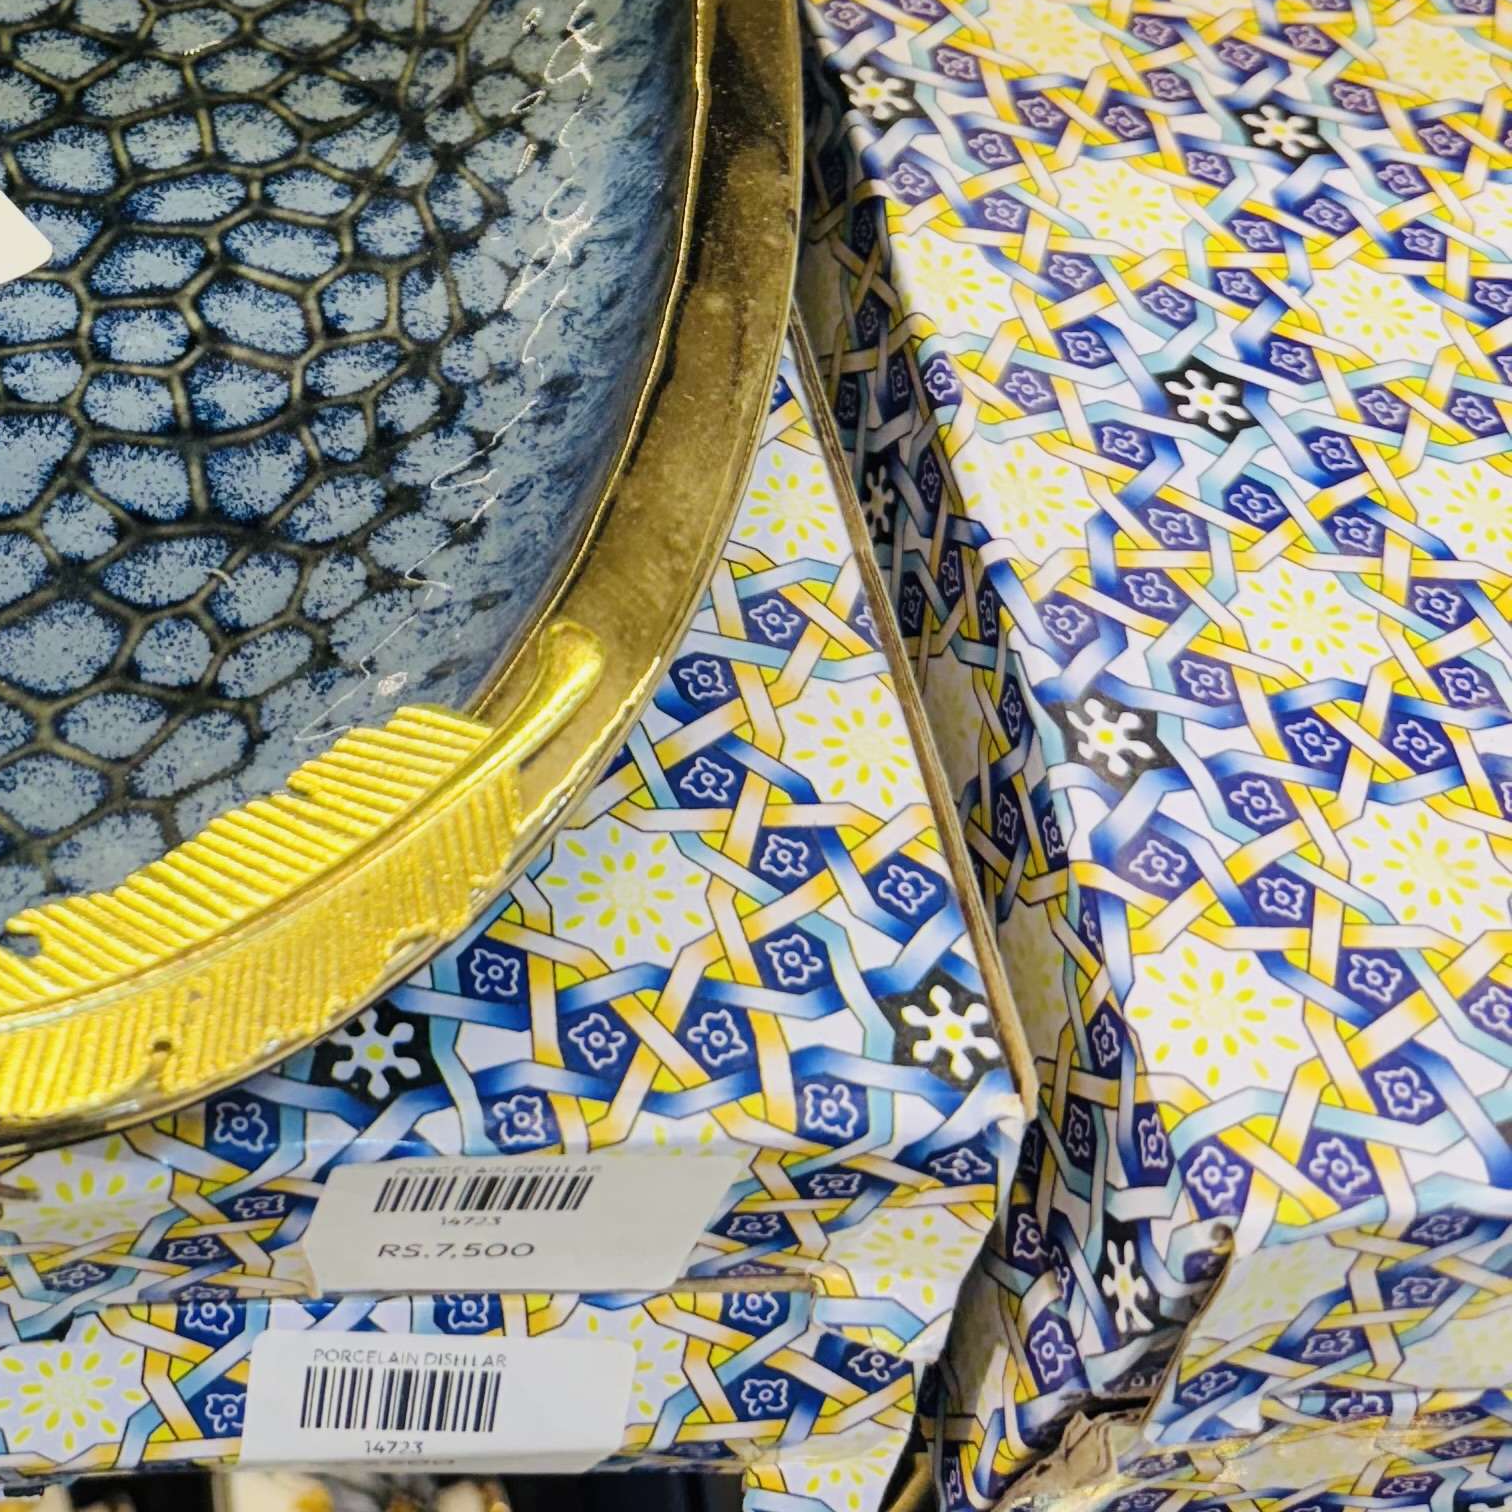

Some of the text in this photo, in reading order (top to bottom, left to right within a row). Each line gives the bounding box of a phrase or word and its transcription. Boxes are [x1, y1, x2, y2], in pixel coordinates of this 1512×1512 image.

[440, 1216, 503, 1227] 14723
[313, 1348, 419, 1366] PORCELAIN
[364, 1440, 424, 1455] 14723
